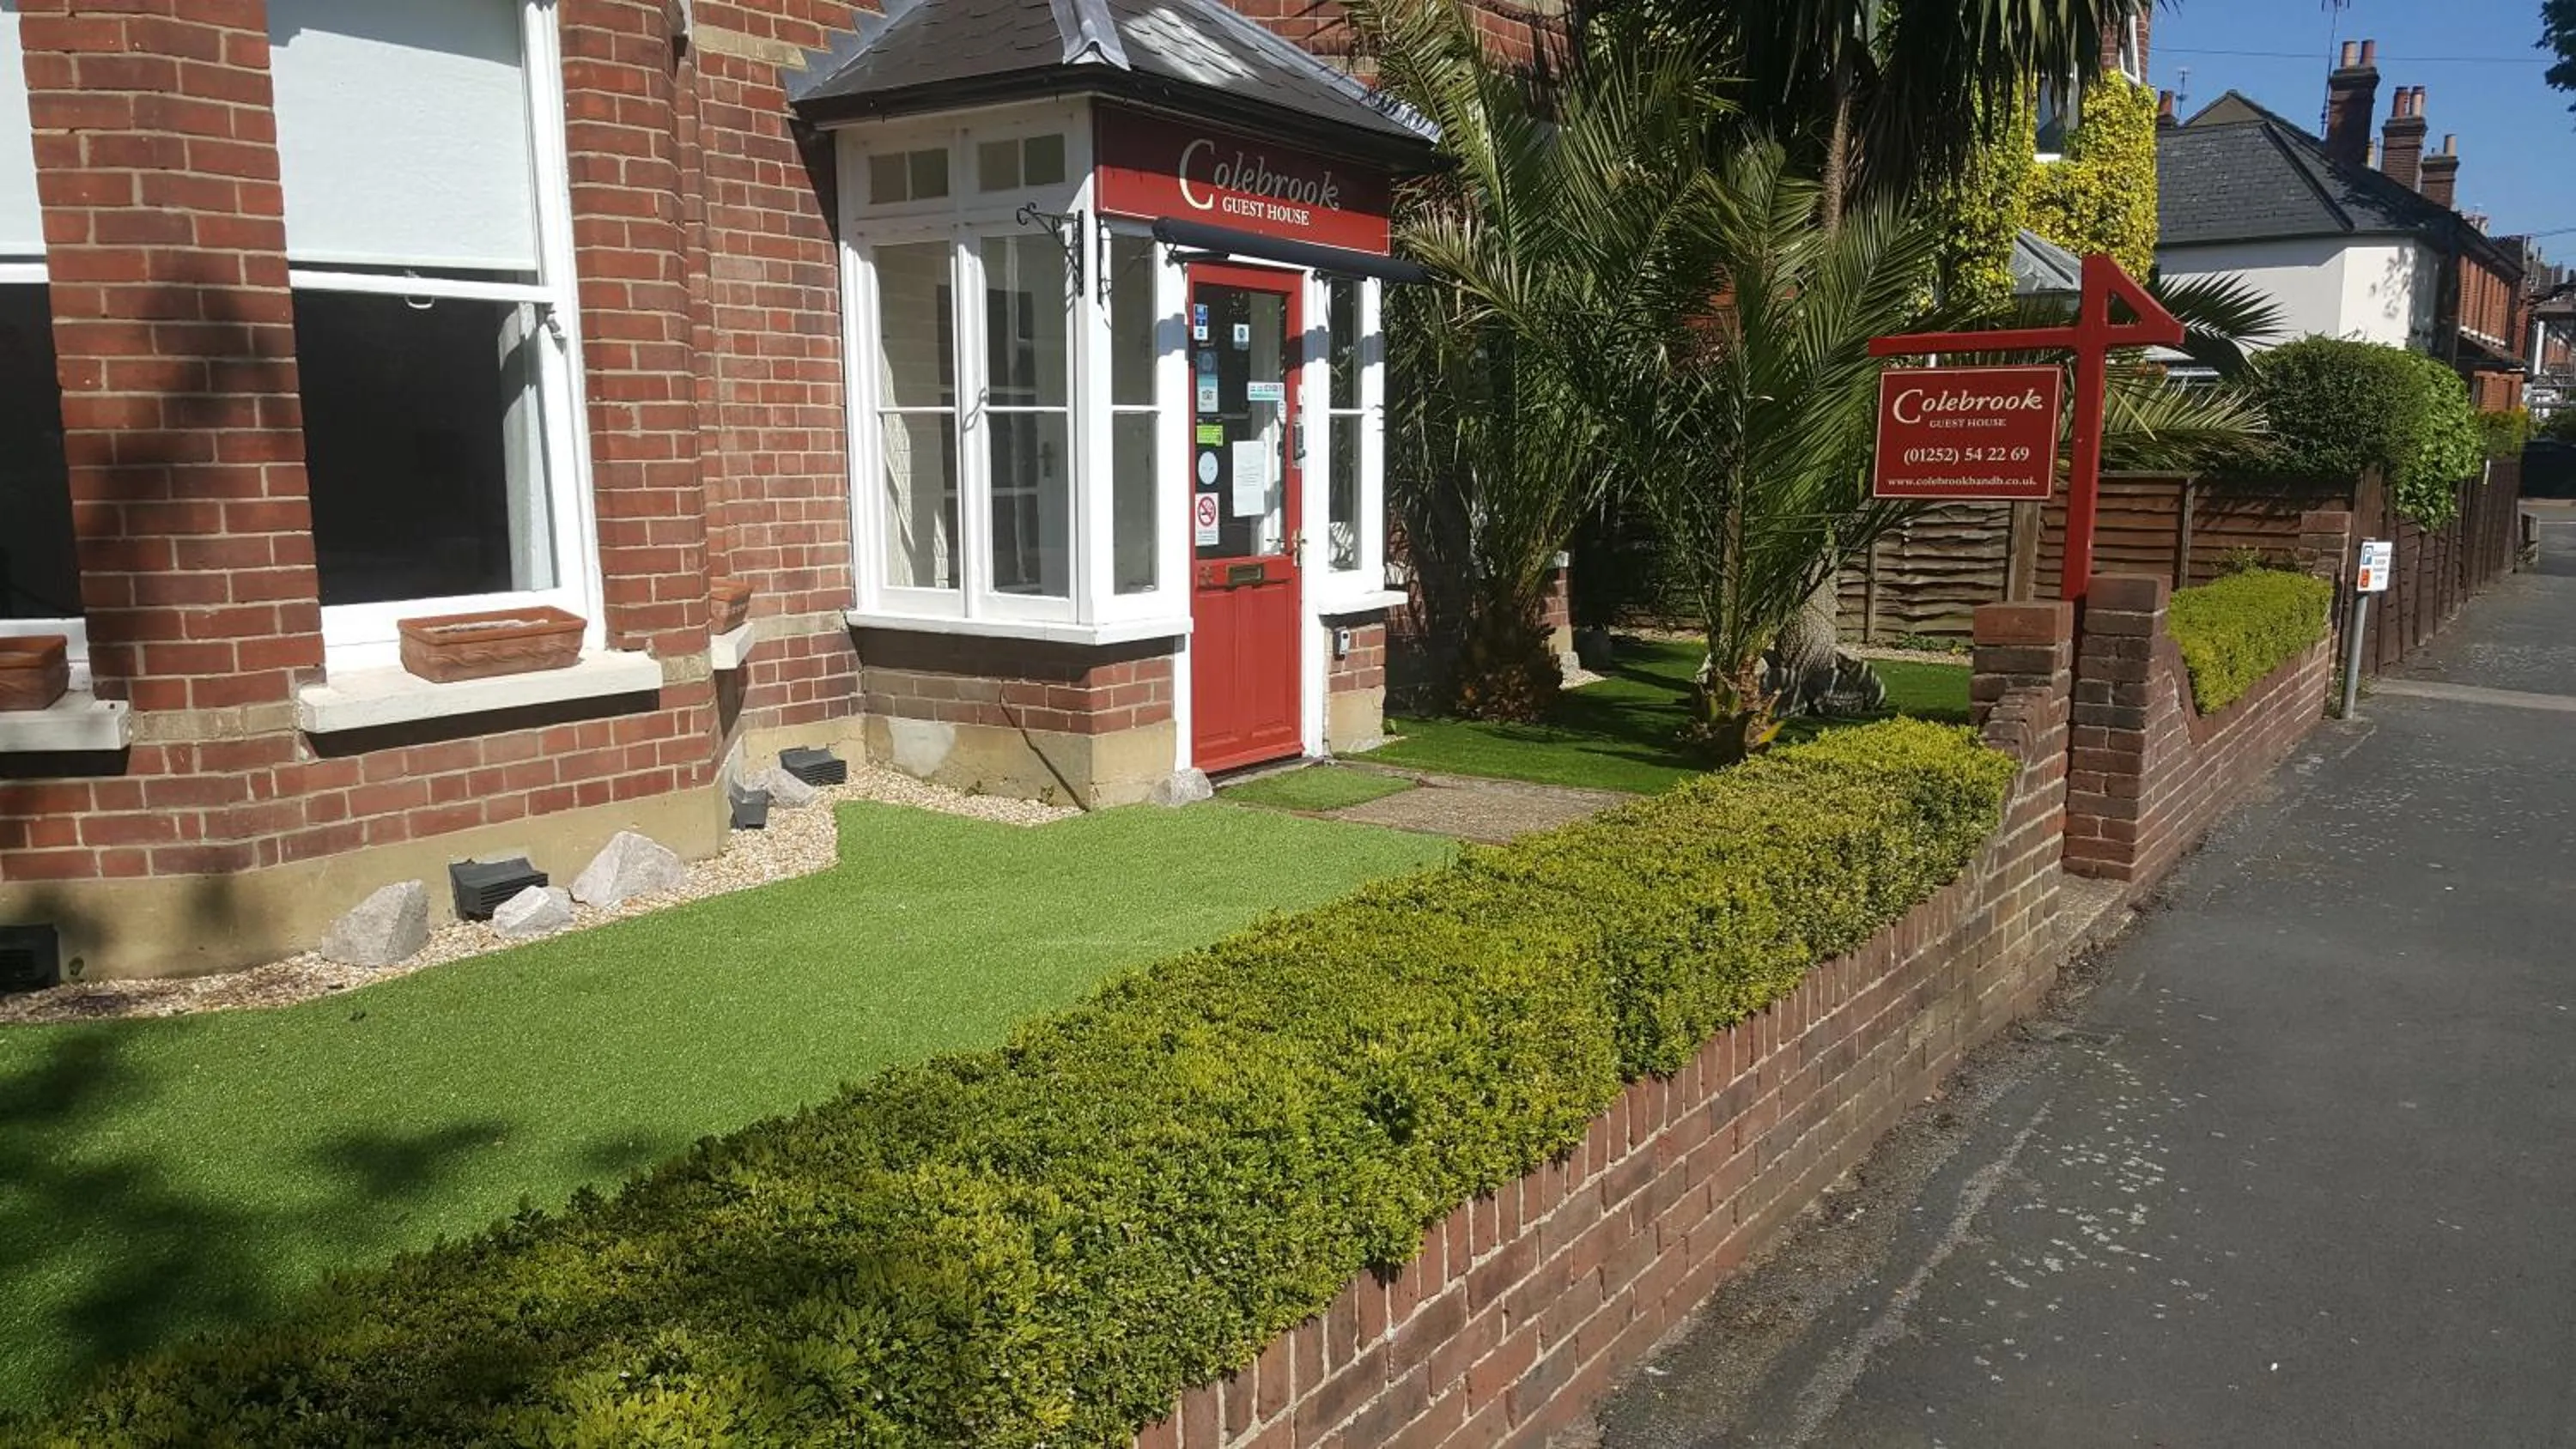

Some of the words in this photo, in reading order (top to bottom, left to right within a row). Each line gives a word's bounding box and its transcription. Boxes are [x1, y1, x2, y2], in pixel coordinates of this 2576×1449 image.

[1179, 138, 1340, 211] Colebrook
[1222, 196, 1265, 217] GUEST
[1267, 203, 1310, 226] HOUSE
[1893, 388, 2044, 424] Colebrook
[1929, 418, 1965, 427] GUEST
[1967, 418, 2007, 427] HOUSE
[1904, 447, 1959, 465] (01252)
[1965, 447, 1982, 462] 54
[1987, 447, 2006, 462] 22
[2010, 446, 2030, 461] 69
